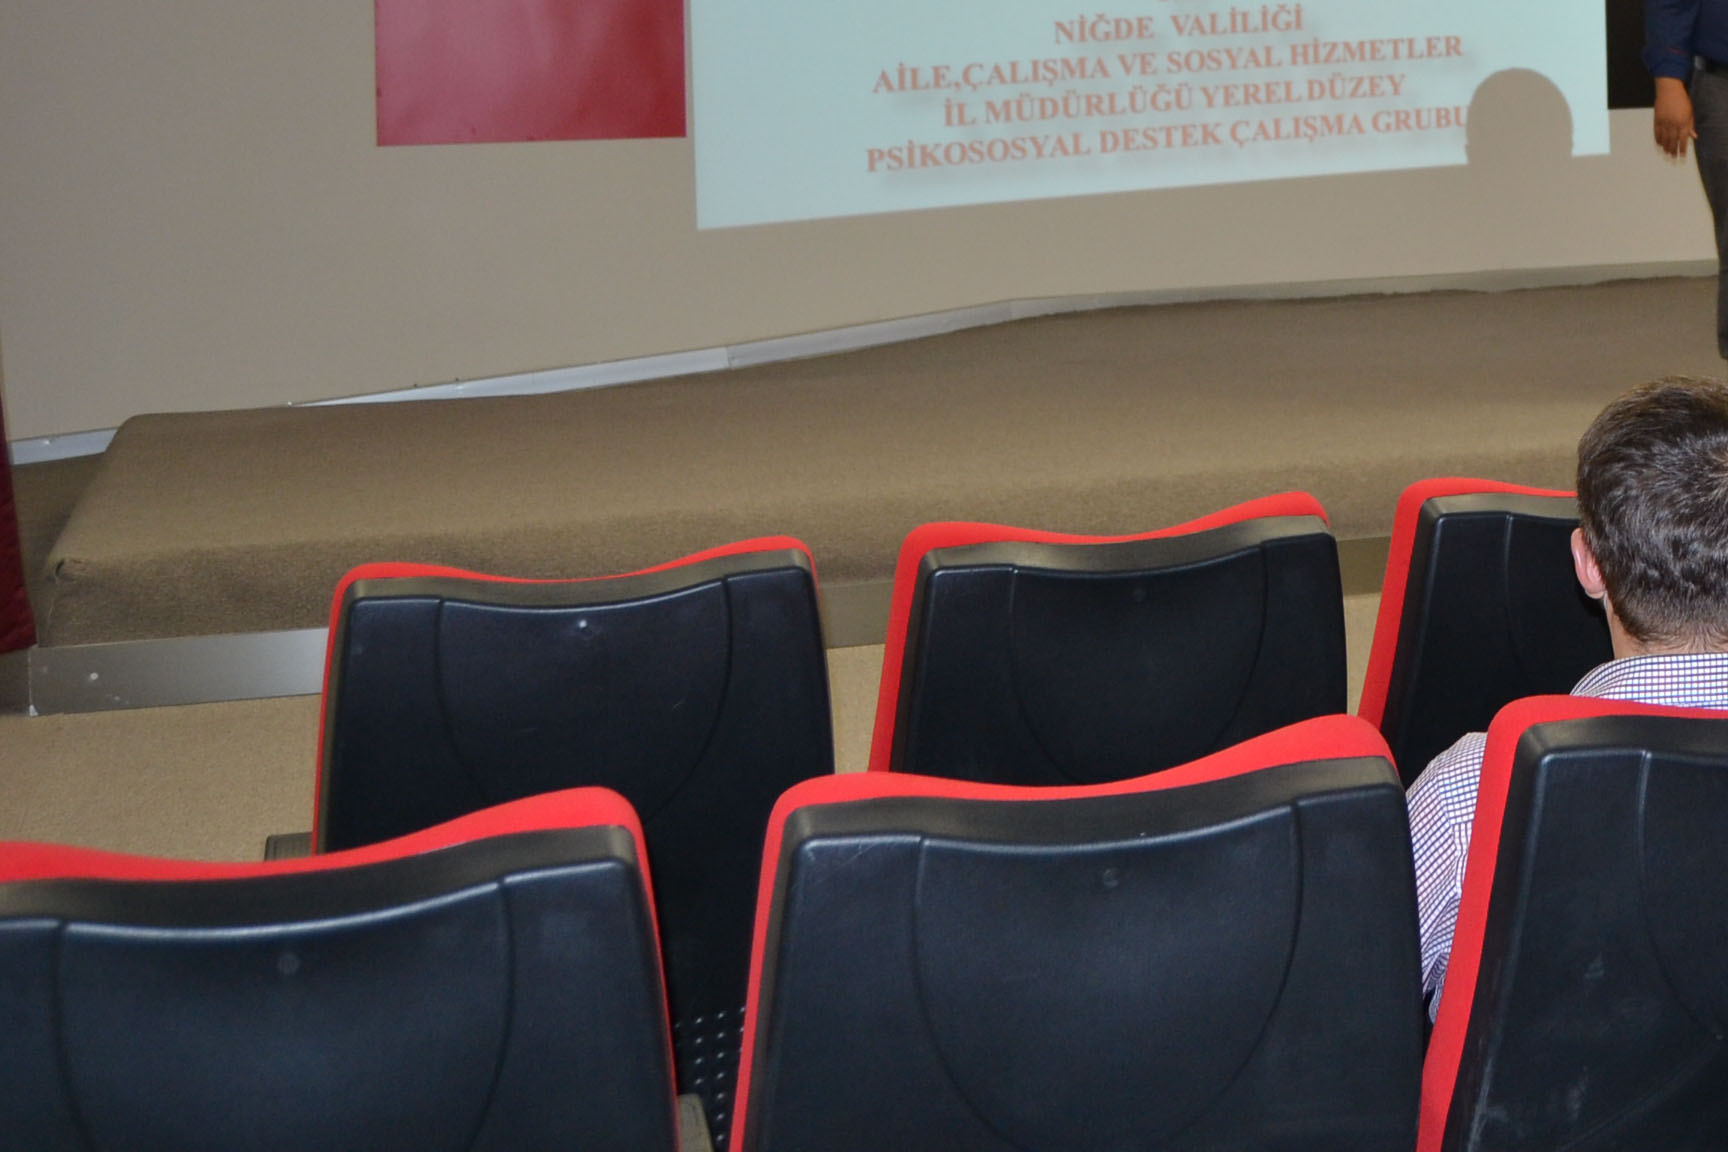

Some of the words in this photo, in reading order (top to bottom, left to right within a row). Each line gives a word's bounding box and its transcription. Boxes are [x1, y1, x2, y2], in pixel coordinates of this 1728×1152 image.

[1054, 13, 1155, 45] NİĞDE
[1170, 3, 1305, 37] VALİLİĞİ
[1117, 51, 1158, 77] VE
[1166, 45, 1283, 74] SOSYAL
[1289, 35, 1465, 67] HİZMETLER
[943, 97, 978, 128] İL
[985, 82, 1193, 125] MÜDÜRLÜĞÜ
[1201, 79, 1301, 110] YEREL
[1306, 72, 1407, 101] DÜZEY
[866, 132, 1092, 173] PSİKOSOSYAL
[1098, 123, 1223, 155] DESTEK
[1229, 112, 1367, 149] ÇALIŞMA
